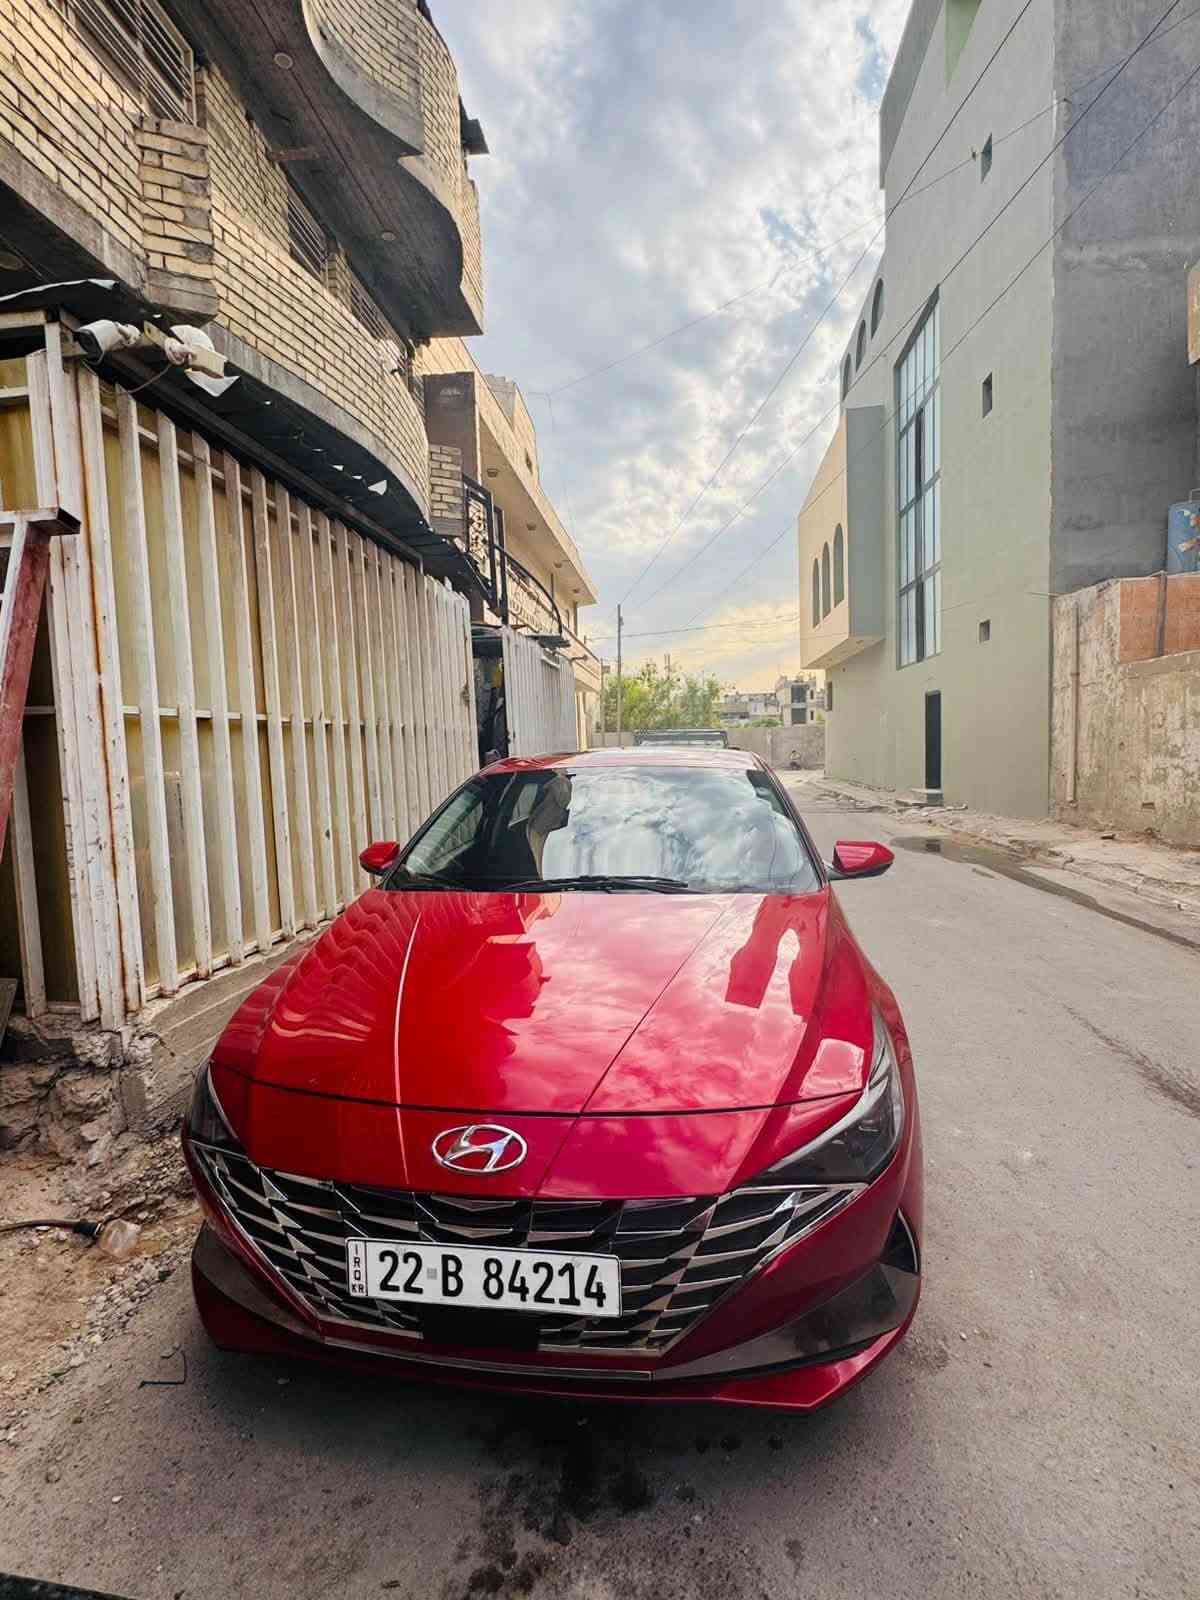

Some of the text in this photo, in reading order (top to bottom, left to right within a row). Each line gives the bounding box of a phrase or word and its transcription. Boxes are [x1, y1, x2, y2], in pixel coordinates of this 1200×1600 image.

[351, 1283, 365, 1294] KR
[378, 1249, 607, 1308] 22 B 84214
